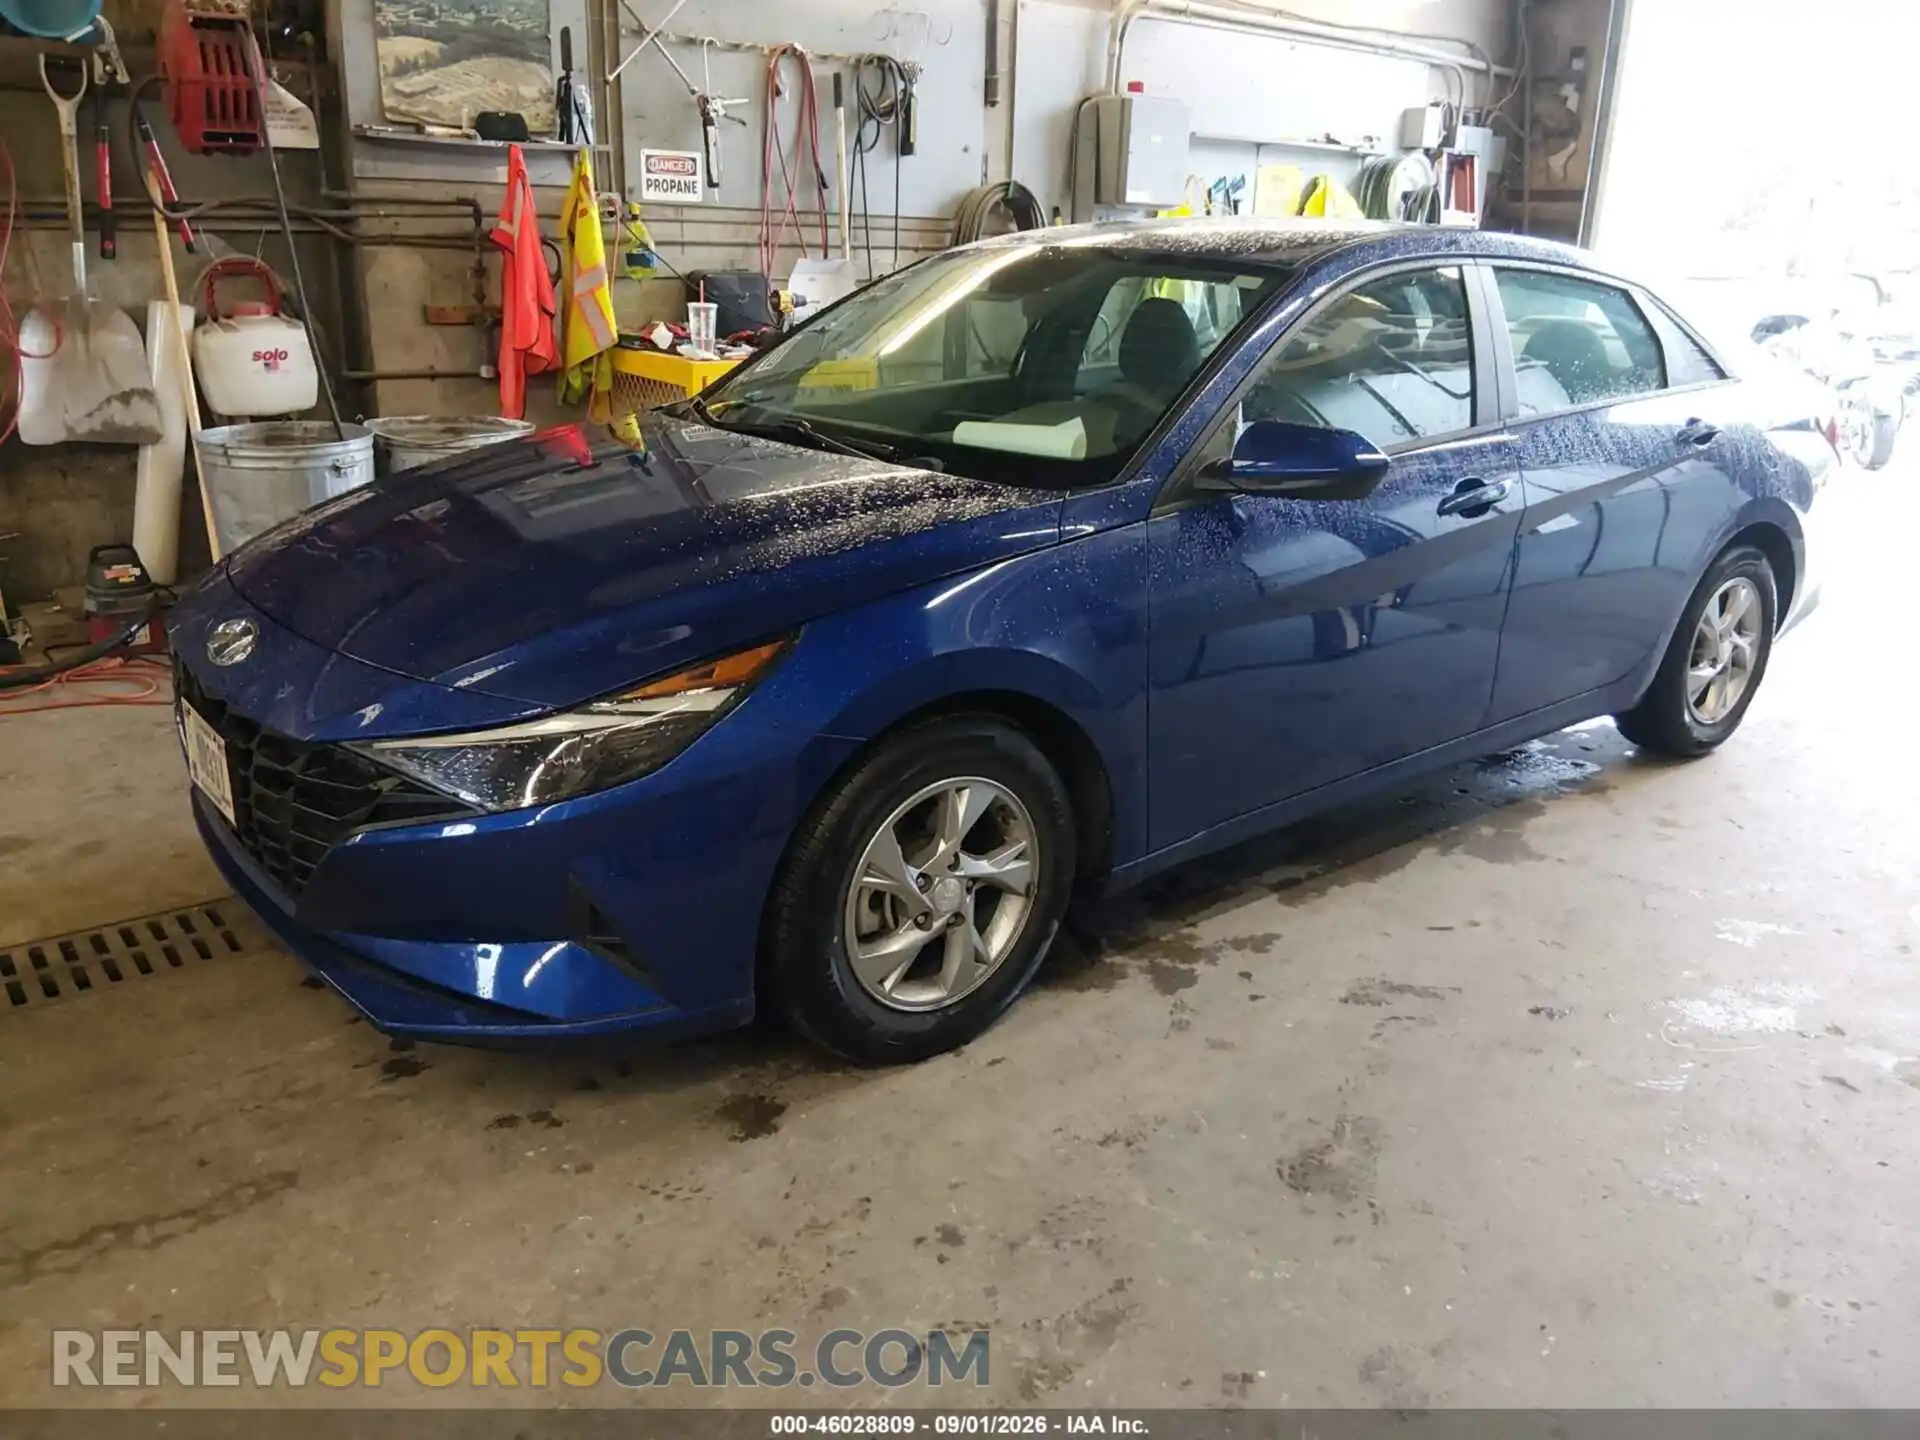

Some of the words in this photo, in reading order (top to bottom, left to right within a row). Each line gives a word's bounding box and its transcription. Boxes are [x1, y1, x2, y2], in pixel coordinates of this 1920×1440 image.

[648, 159, 696, 172] DANGER
[646, 178, 698, 194] PROPANE
[252, 347, 288, 361] solo
